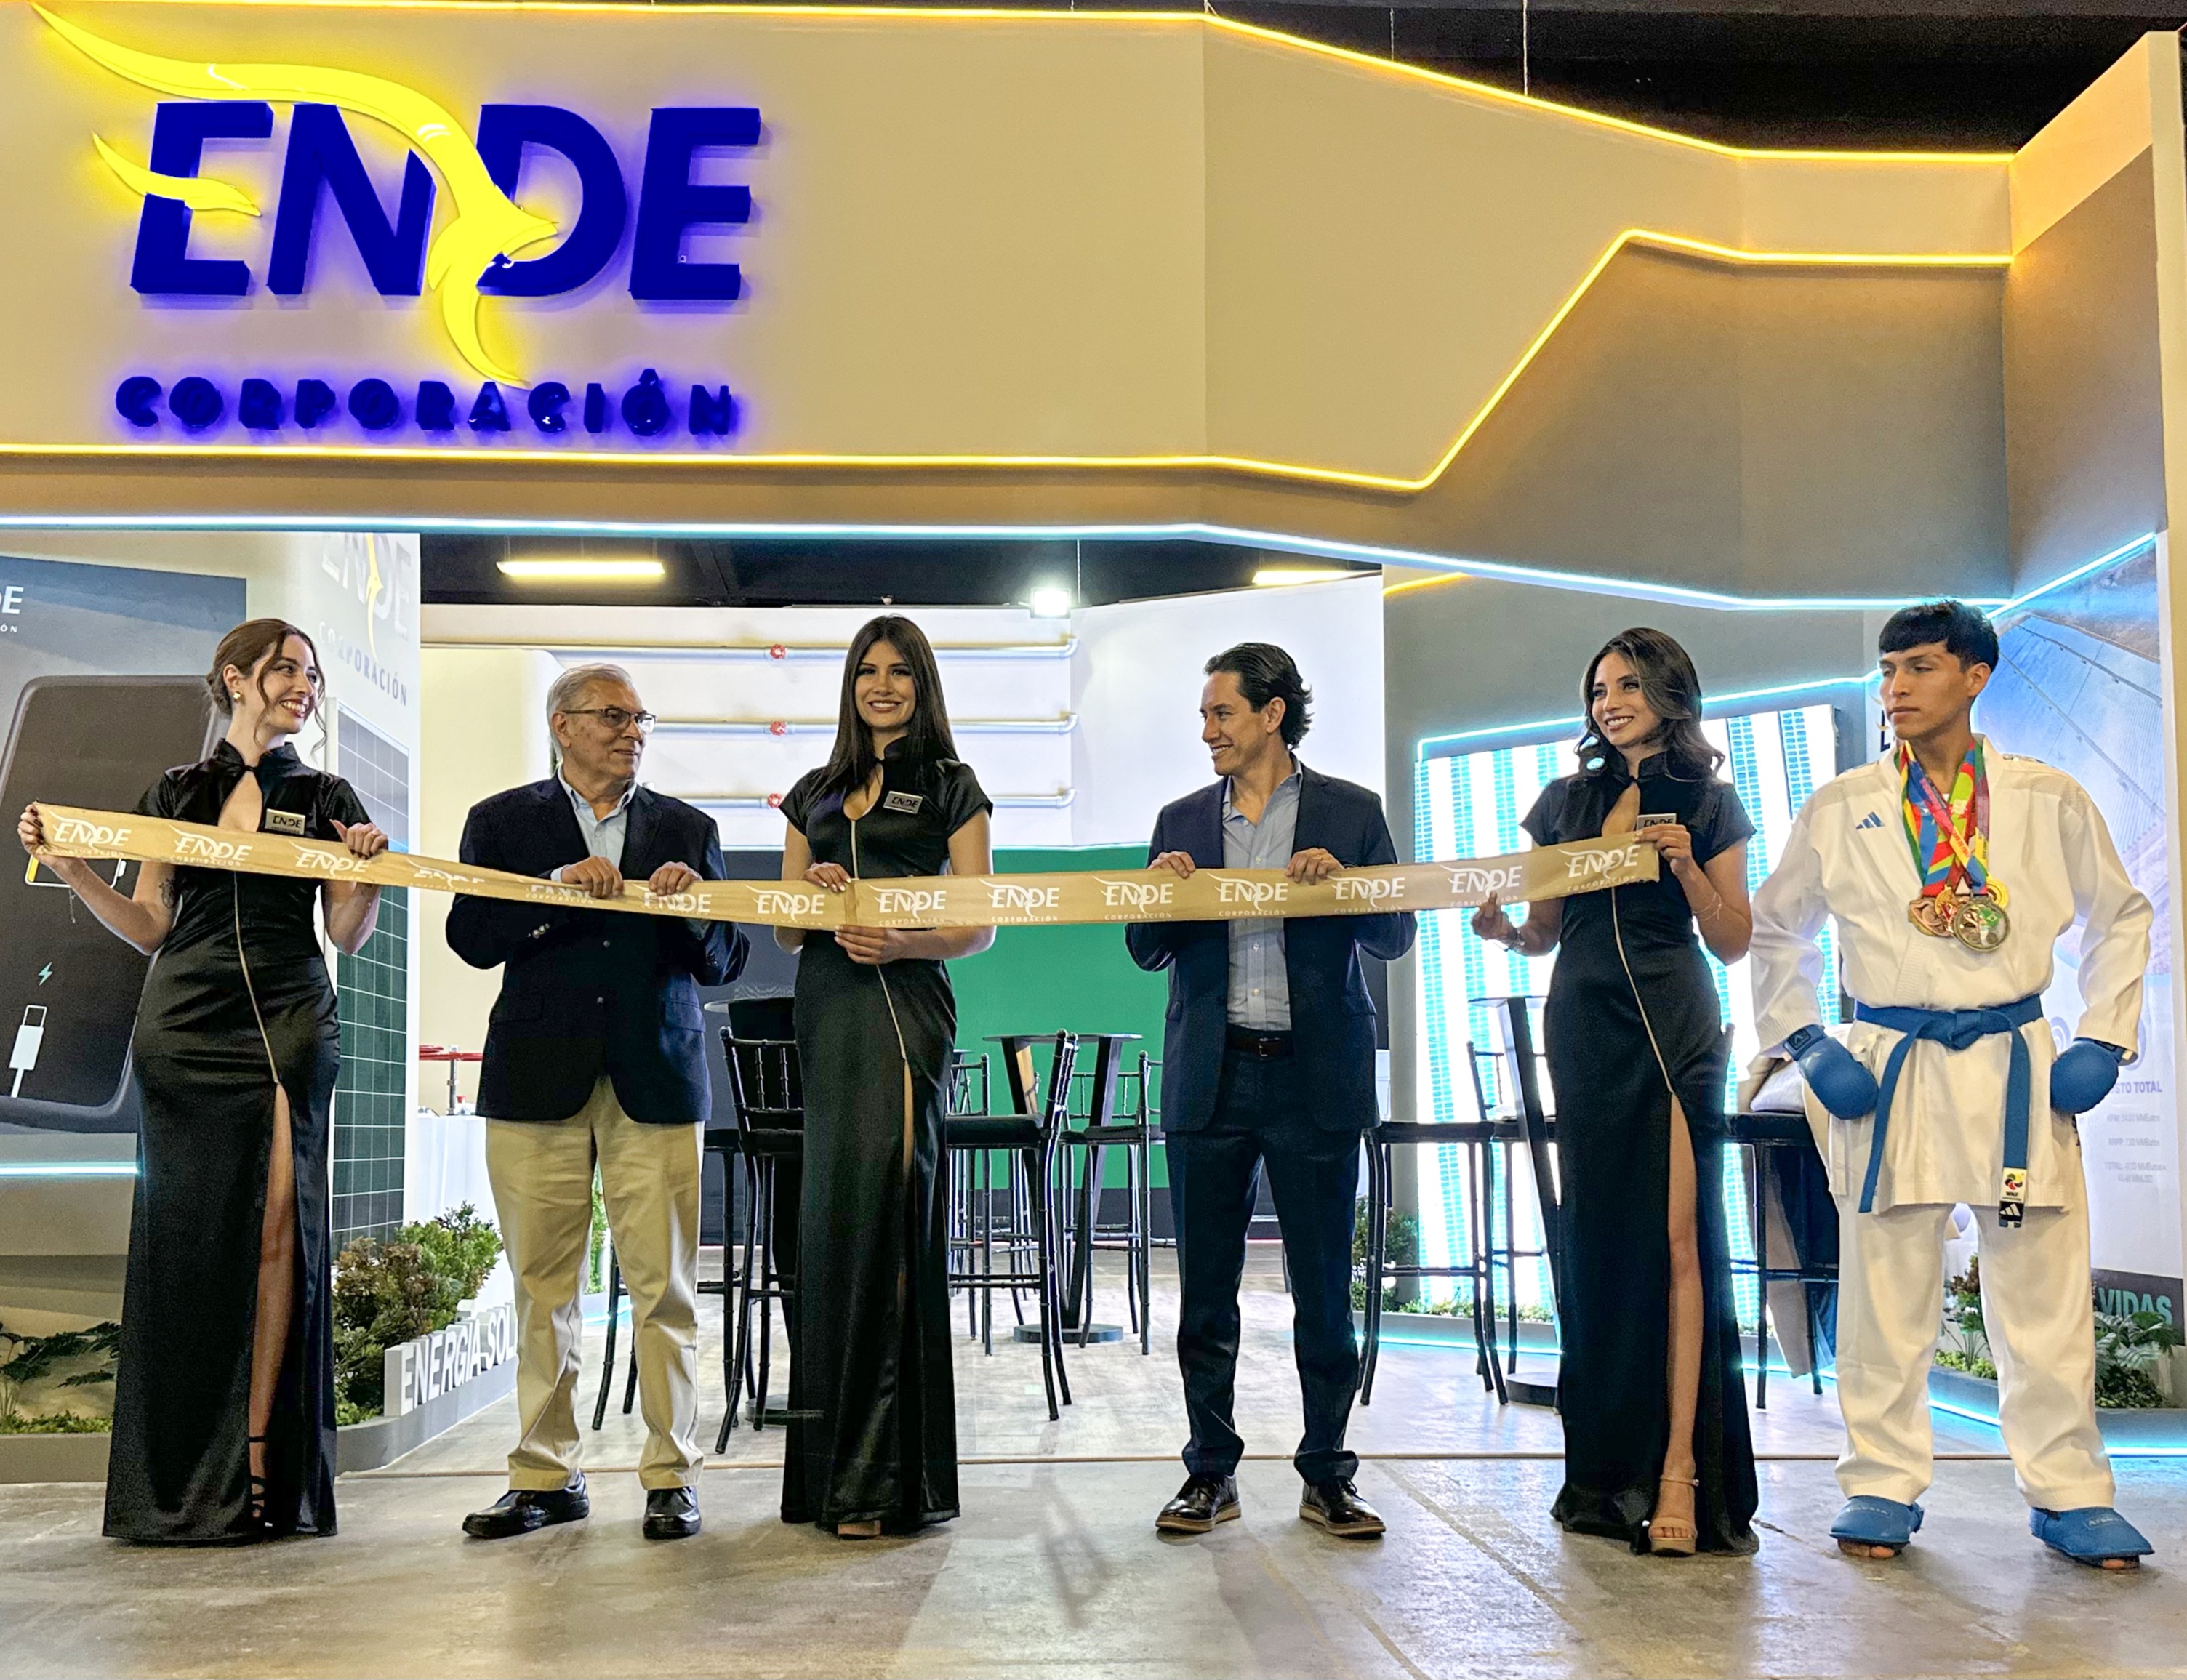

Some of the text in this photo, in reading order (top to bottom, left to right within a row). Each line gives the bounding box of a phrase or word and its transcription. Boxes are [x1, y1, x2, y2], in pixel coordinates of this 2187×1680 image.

[130, 102, 767, 300] ENDE
[116, 369, 731, 436] CORPORACIÓN
[892, 797, 919, 808] ENDE
[273, 816, 302, 828] ENDE
[54, 822, 132, 847] ENDE
[174, 837, 252, 861] ENDE
[295, 853, 372, 872] ENDE
[1568, 845, 1641, 878] ENDE
[1336, 877, 1405, 900] ENDE
[1451, 865, 1522, 893] ENDE
[757, 894, 825, 914] ENDE
[879, 891, 947, 913] ENDE
[992, 888, 1059, 908] ENDE
[1105, 883, 1173, 906] ENDE
[1220, 883, 1288, 902] ENDE
[2134, 1080, 2162, 1093] TOTAL
[2098, 1286, 2172, 1325] VIDAS
